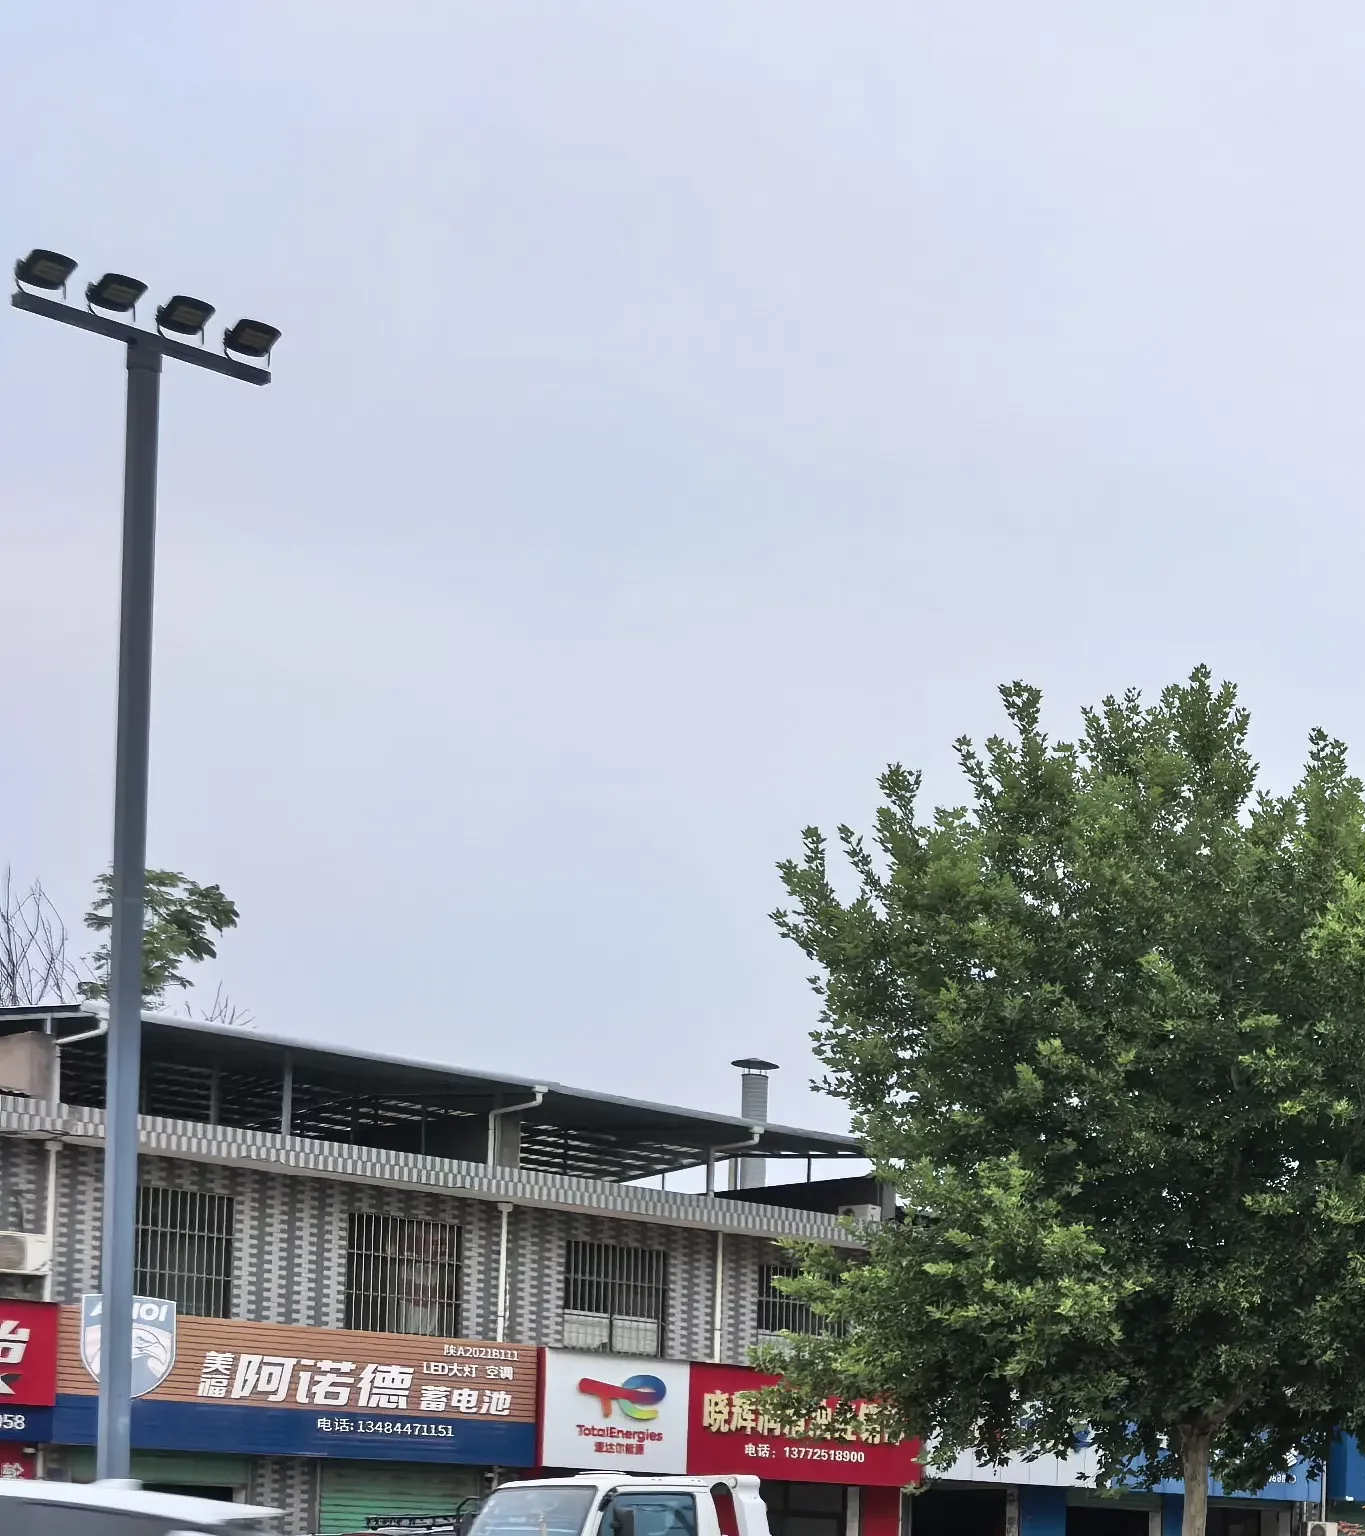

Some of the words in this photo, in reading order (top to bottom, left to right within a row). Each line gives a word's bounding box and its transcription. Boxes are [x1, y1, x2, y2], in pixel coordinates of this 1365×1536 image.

[198, 1351, 235, 1398] 美福
[231, 1353, 414, 1409] 阿诺德
[422, 1361, 478, 1378] LED大灯
[486, 1366, 514, 1380] 空调
[419, 1385, 512, 1416] 蓄电池
[576, 1425, 663, 1443] TotalEnergies
